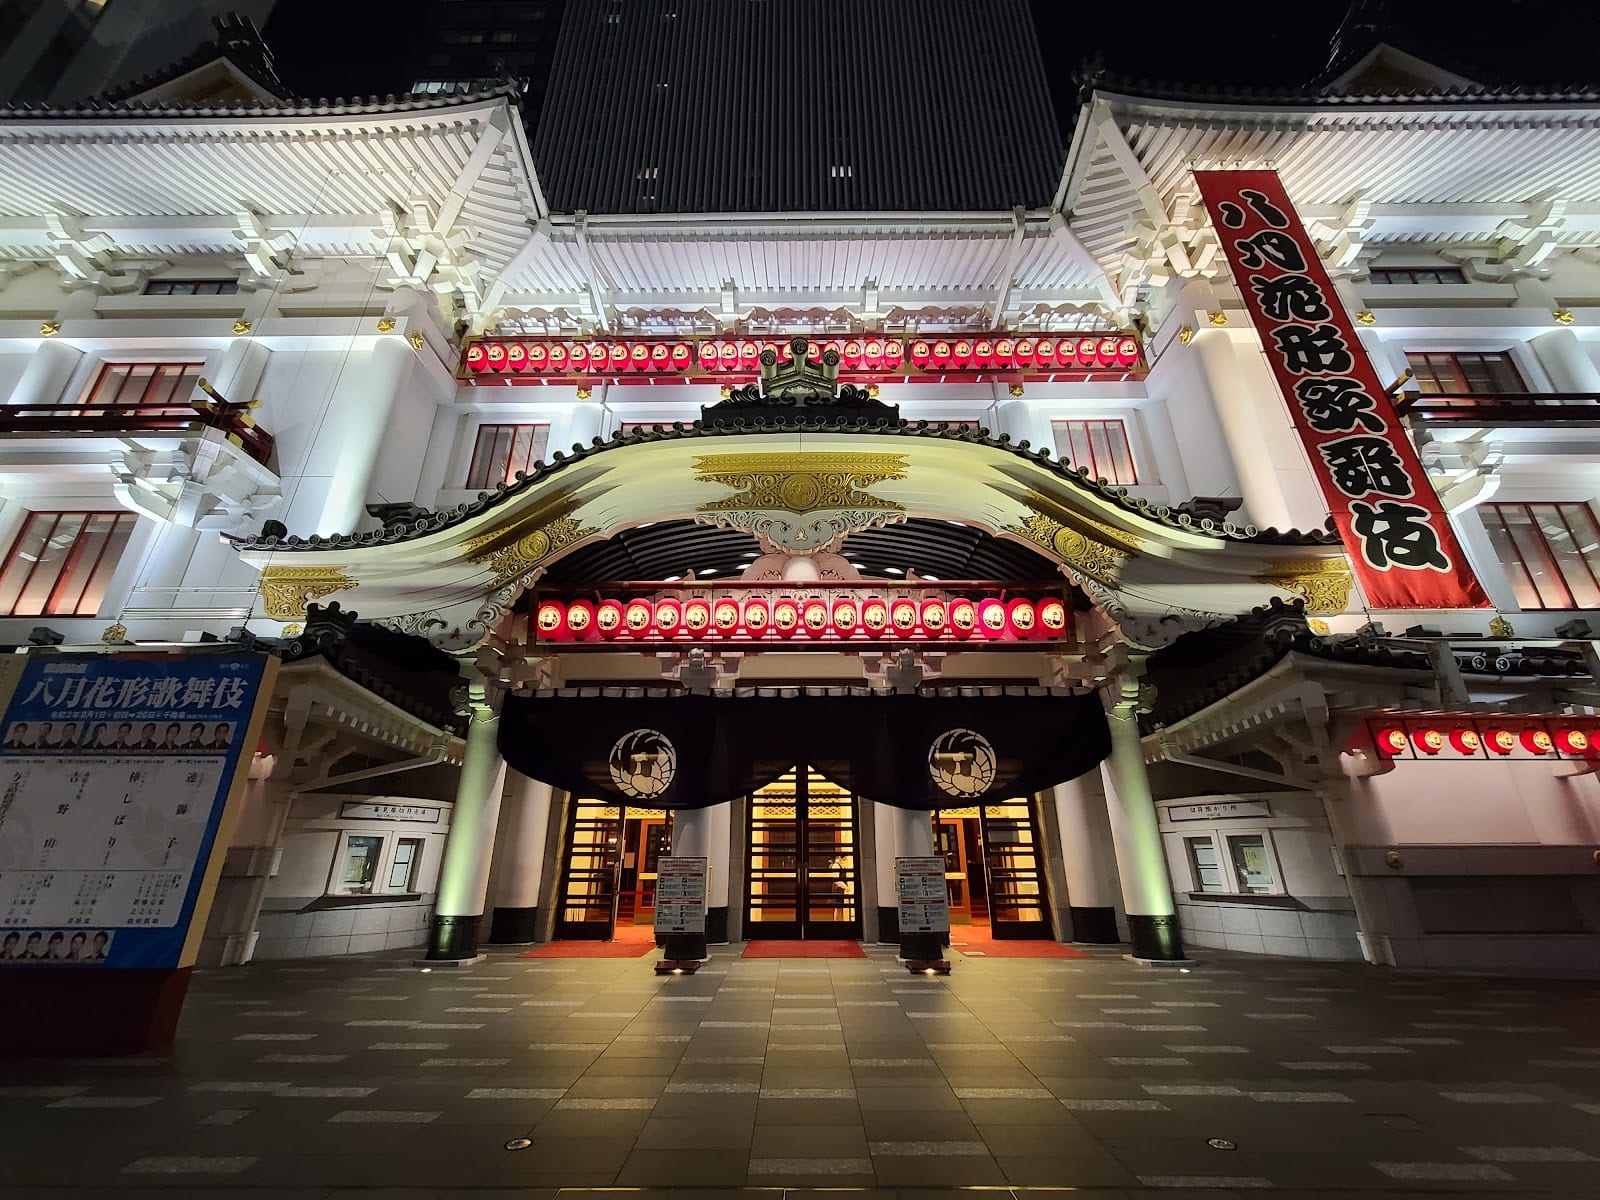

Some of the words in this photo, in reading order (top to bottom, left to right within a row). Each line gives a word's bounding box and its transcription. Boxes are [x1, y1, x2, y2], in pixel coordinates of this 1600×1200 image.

[1218, 188, 1452, 574] 八月花形歌舞伎
[21, 676, 248, 709] 八月花形歌舞伎
